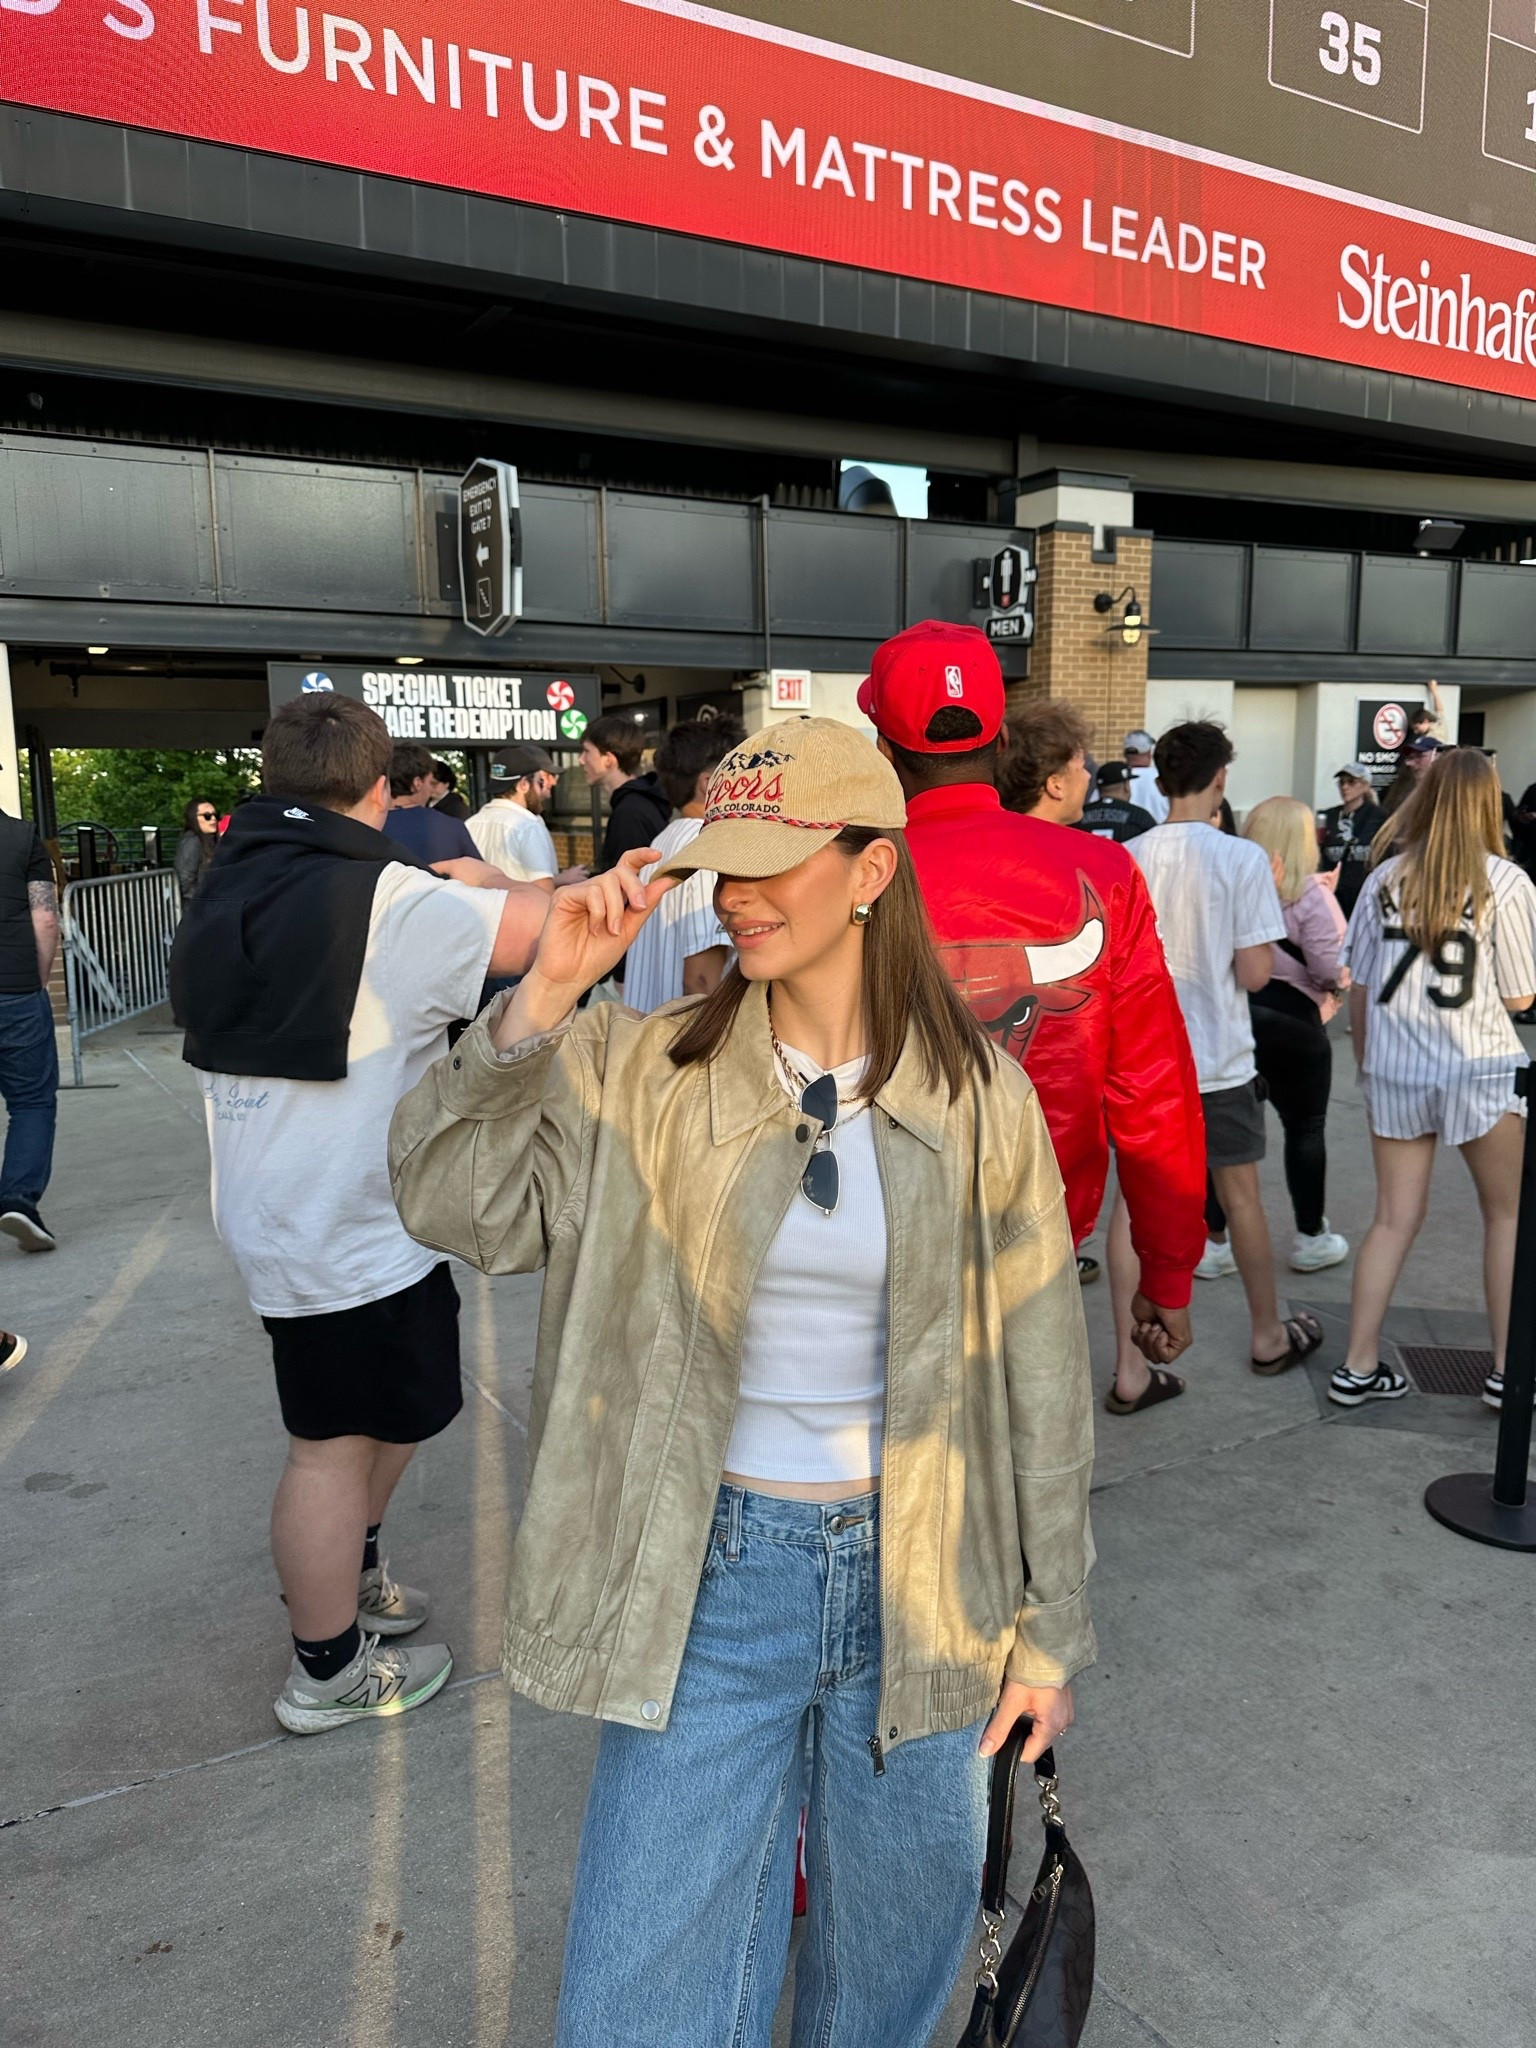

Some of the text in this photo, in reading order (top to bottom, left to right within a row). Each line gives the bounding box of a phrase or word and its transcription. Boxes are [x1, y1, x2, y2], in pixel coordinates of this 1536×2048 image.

[1319, 11, 1381, 86] 35
[196, 0, 1267, 290] FURNITURE & MATTRESS LEADER
[463, 477, 497, 502] EMERGENCY
[469, 501, 483, 518] EXIT
[471, 517, 486, 534] GATE
[990, 618, 1020, 636] MEN
[362, 672, 522, 708] SPECIAL TICKET
[777, 679, 803, 700] EXIT
[428, 707, 557, 740] REDEMPTION
[1358, 752, 1374, 763] NO
[719, 803, 781, 813] COLORADO
[1377, 928, 1476, 1008] 79
